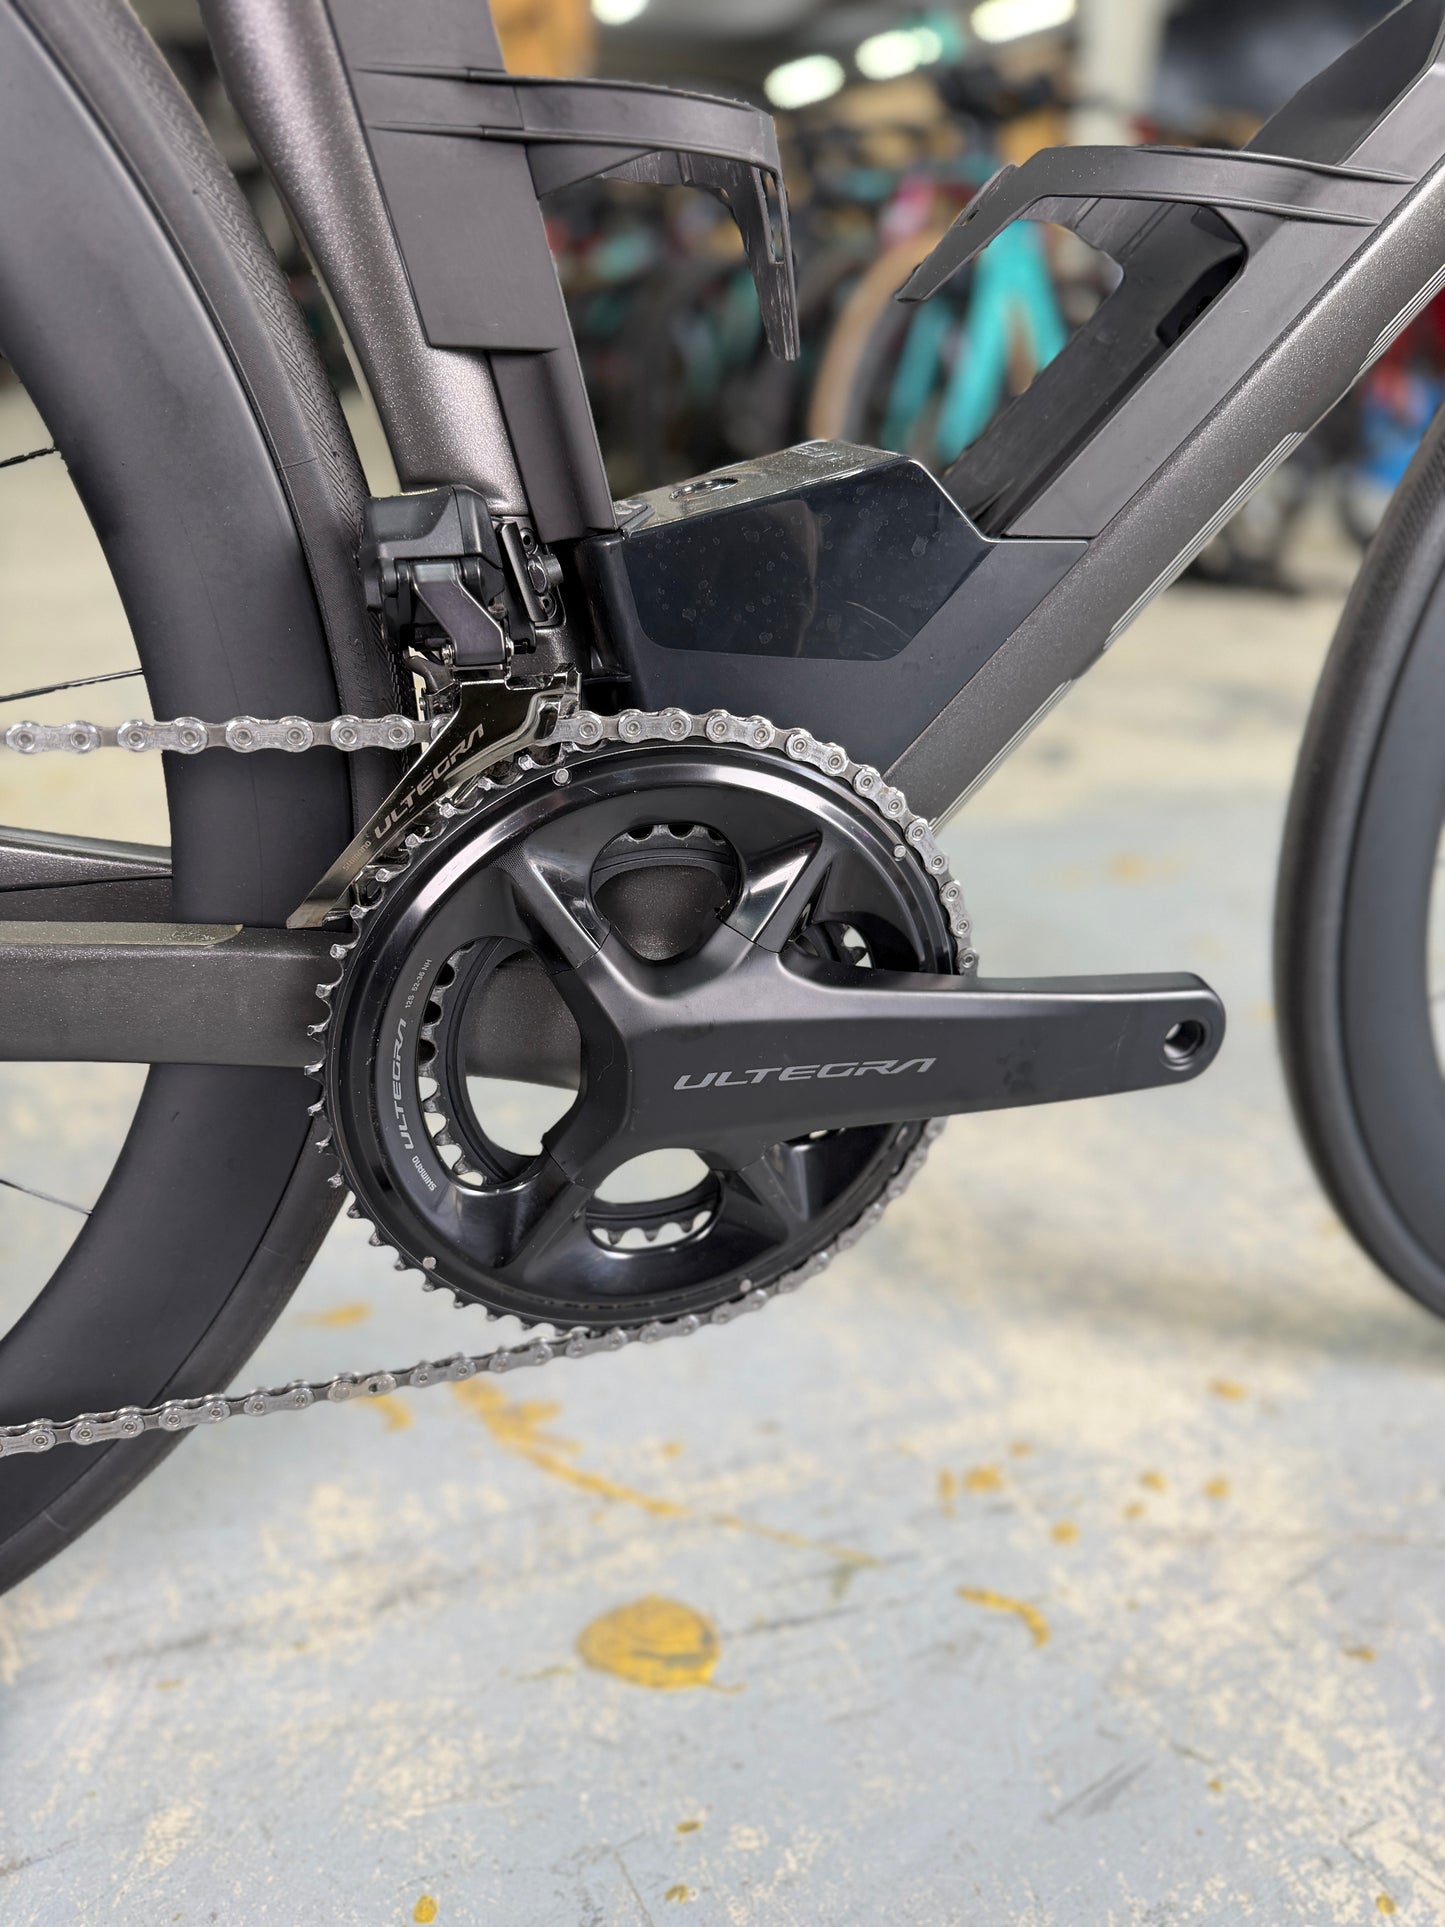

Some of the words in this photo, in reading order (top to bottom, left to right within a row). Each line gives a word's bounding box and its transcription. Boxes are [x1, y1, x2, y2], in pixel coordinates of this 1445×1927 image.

[374, 723, 485, 839] ULTEGRA
[405, 994, 415, 1008] 12S
[411, 971, 425, 992] 52-36
[421, 959, 433, 971] NH
[391, 1017, 415, 1150] ULTEGRA
[673, 1056, 937, 1090] ULTEGRA
[411, 1155, 438, 1192] SHIMANO
